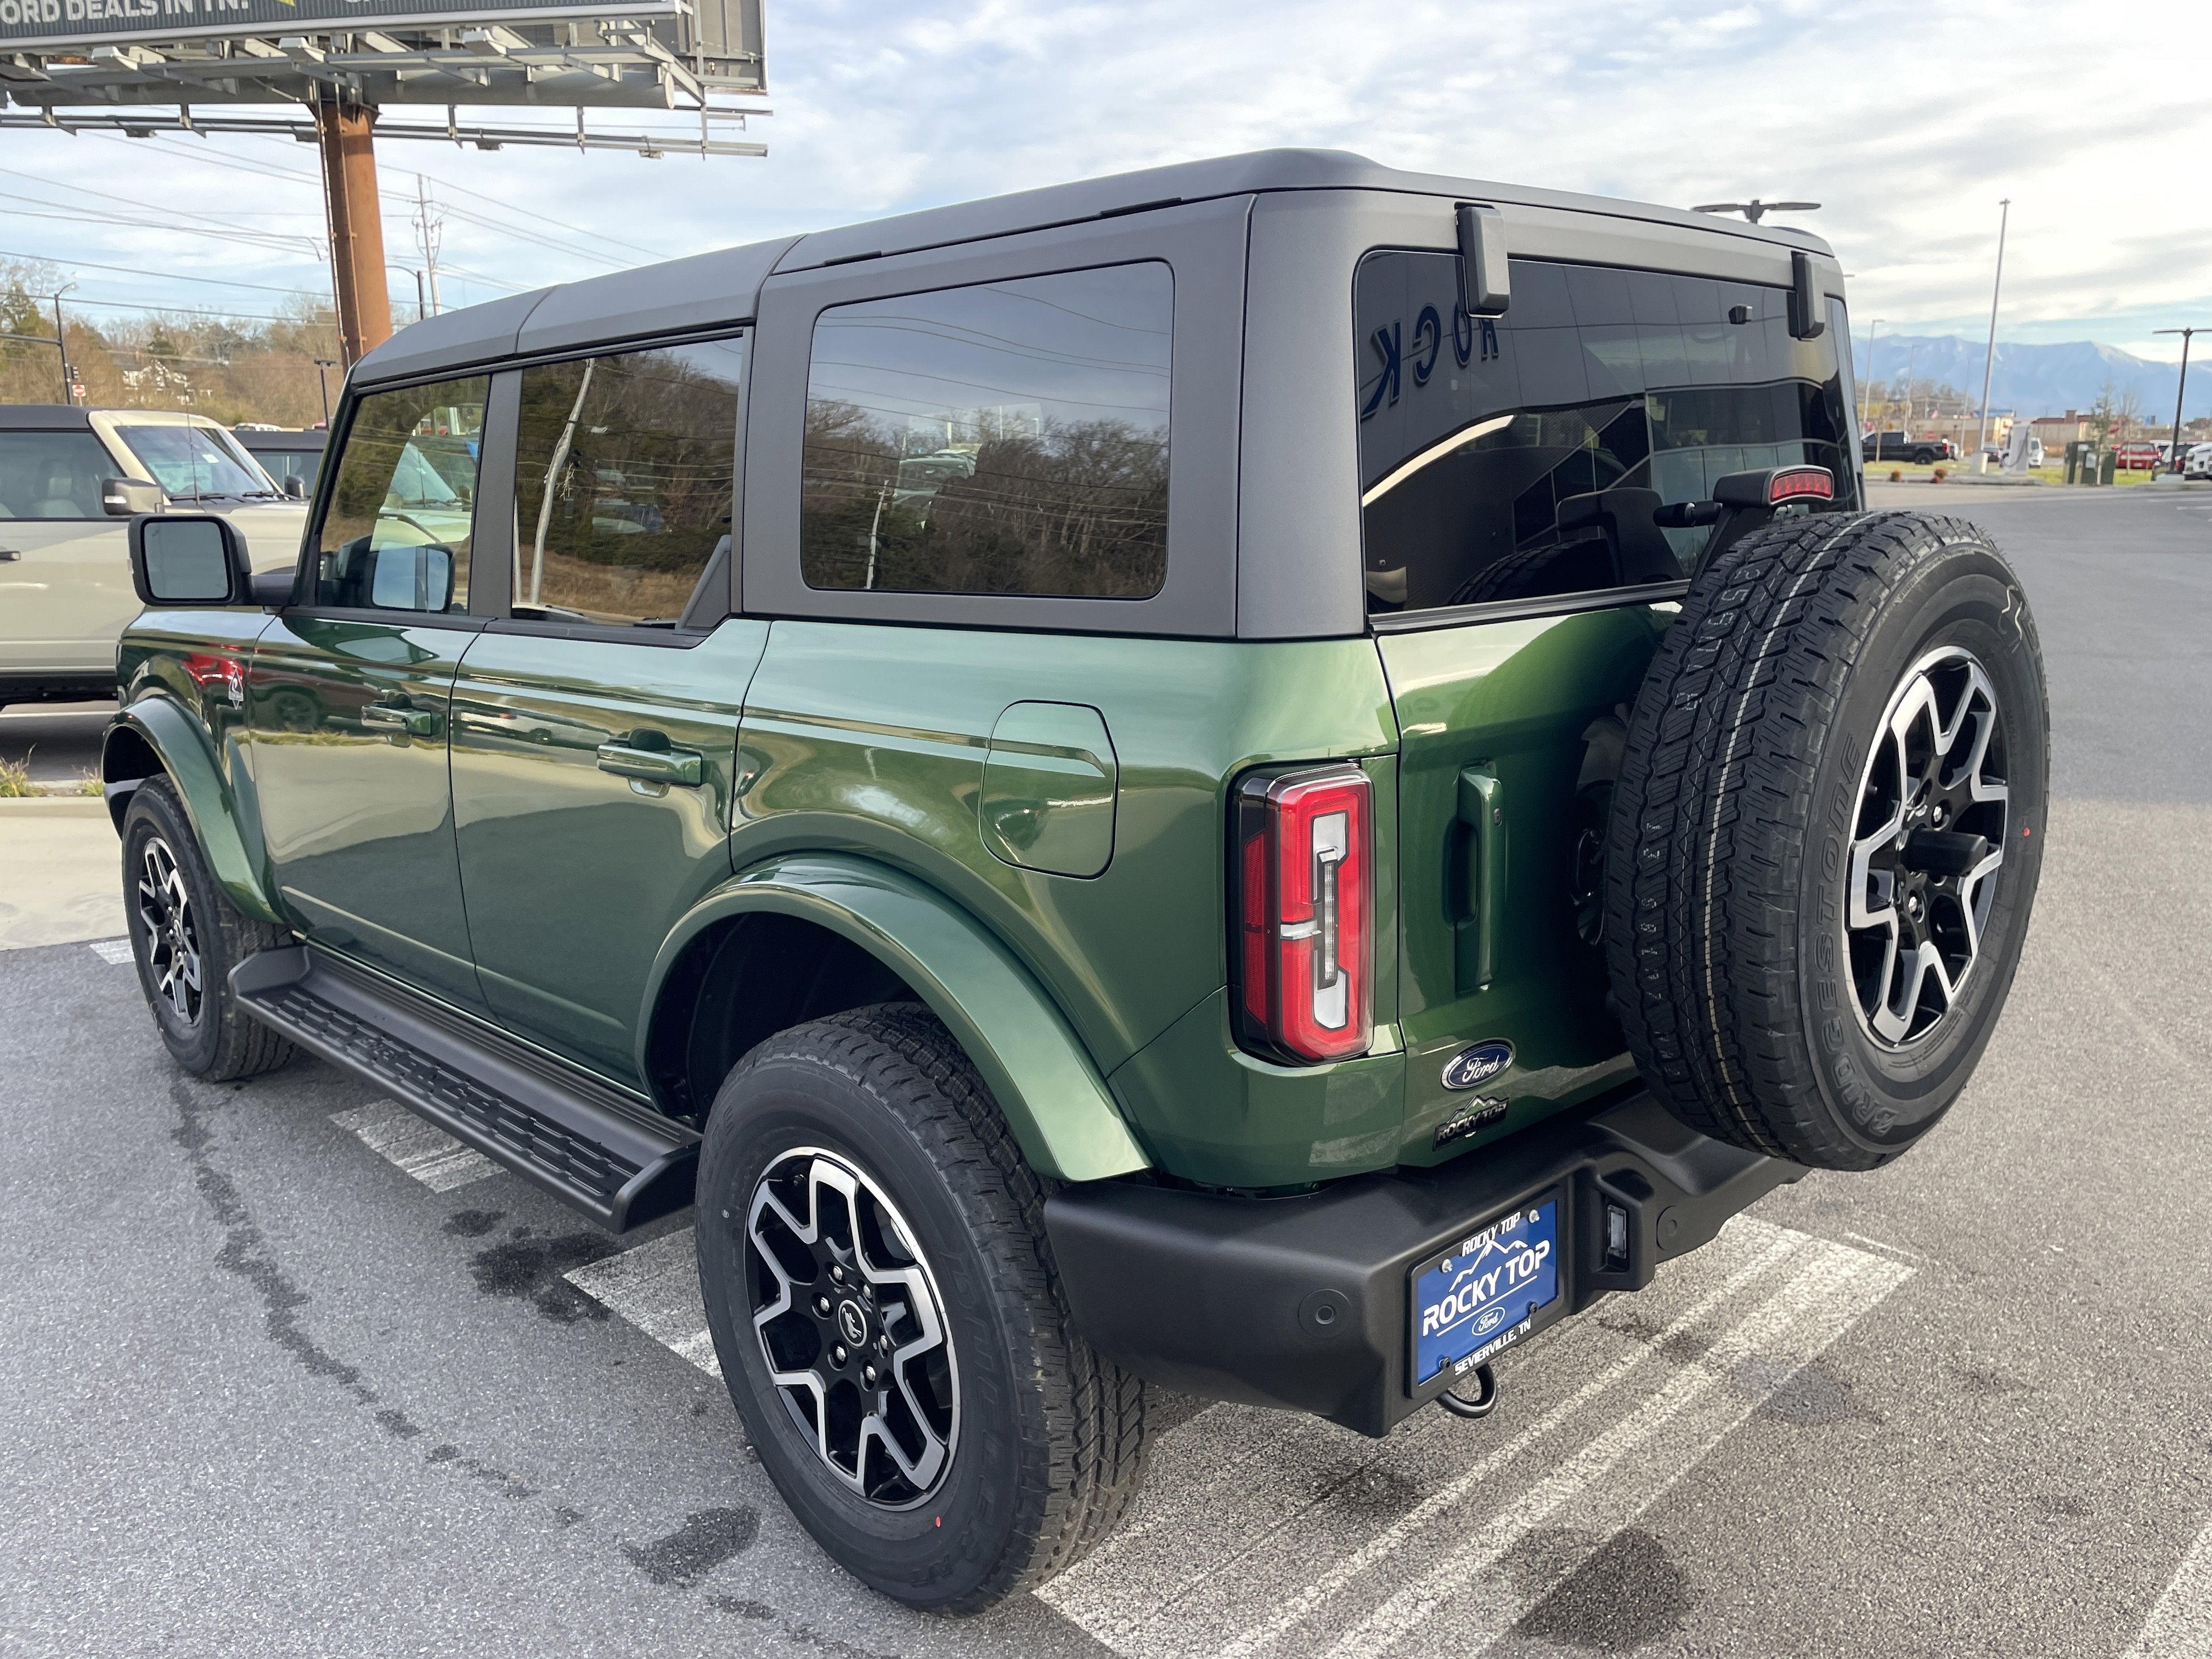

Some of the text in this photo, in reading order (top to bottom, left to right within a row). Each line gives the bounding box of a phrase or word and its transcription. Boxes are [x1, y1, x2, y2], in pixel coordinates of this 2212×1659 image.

[65, 0, 159, 20] DEALS
[1462, 1053, 1499, 1083] Ford
[1437, 1103, 1508, 1142] ROCKY TOP
[1462, 1211, 1521, 1257] ROCKY TOP
[1422, 1239, 1550, 1336] ROCKY TOP
[1478, 1312, 1499, 1332] Ford
[1454, 1318, 1532, 1376] SEVIERVILLE, TN
